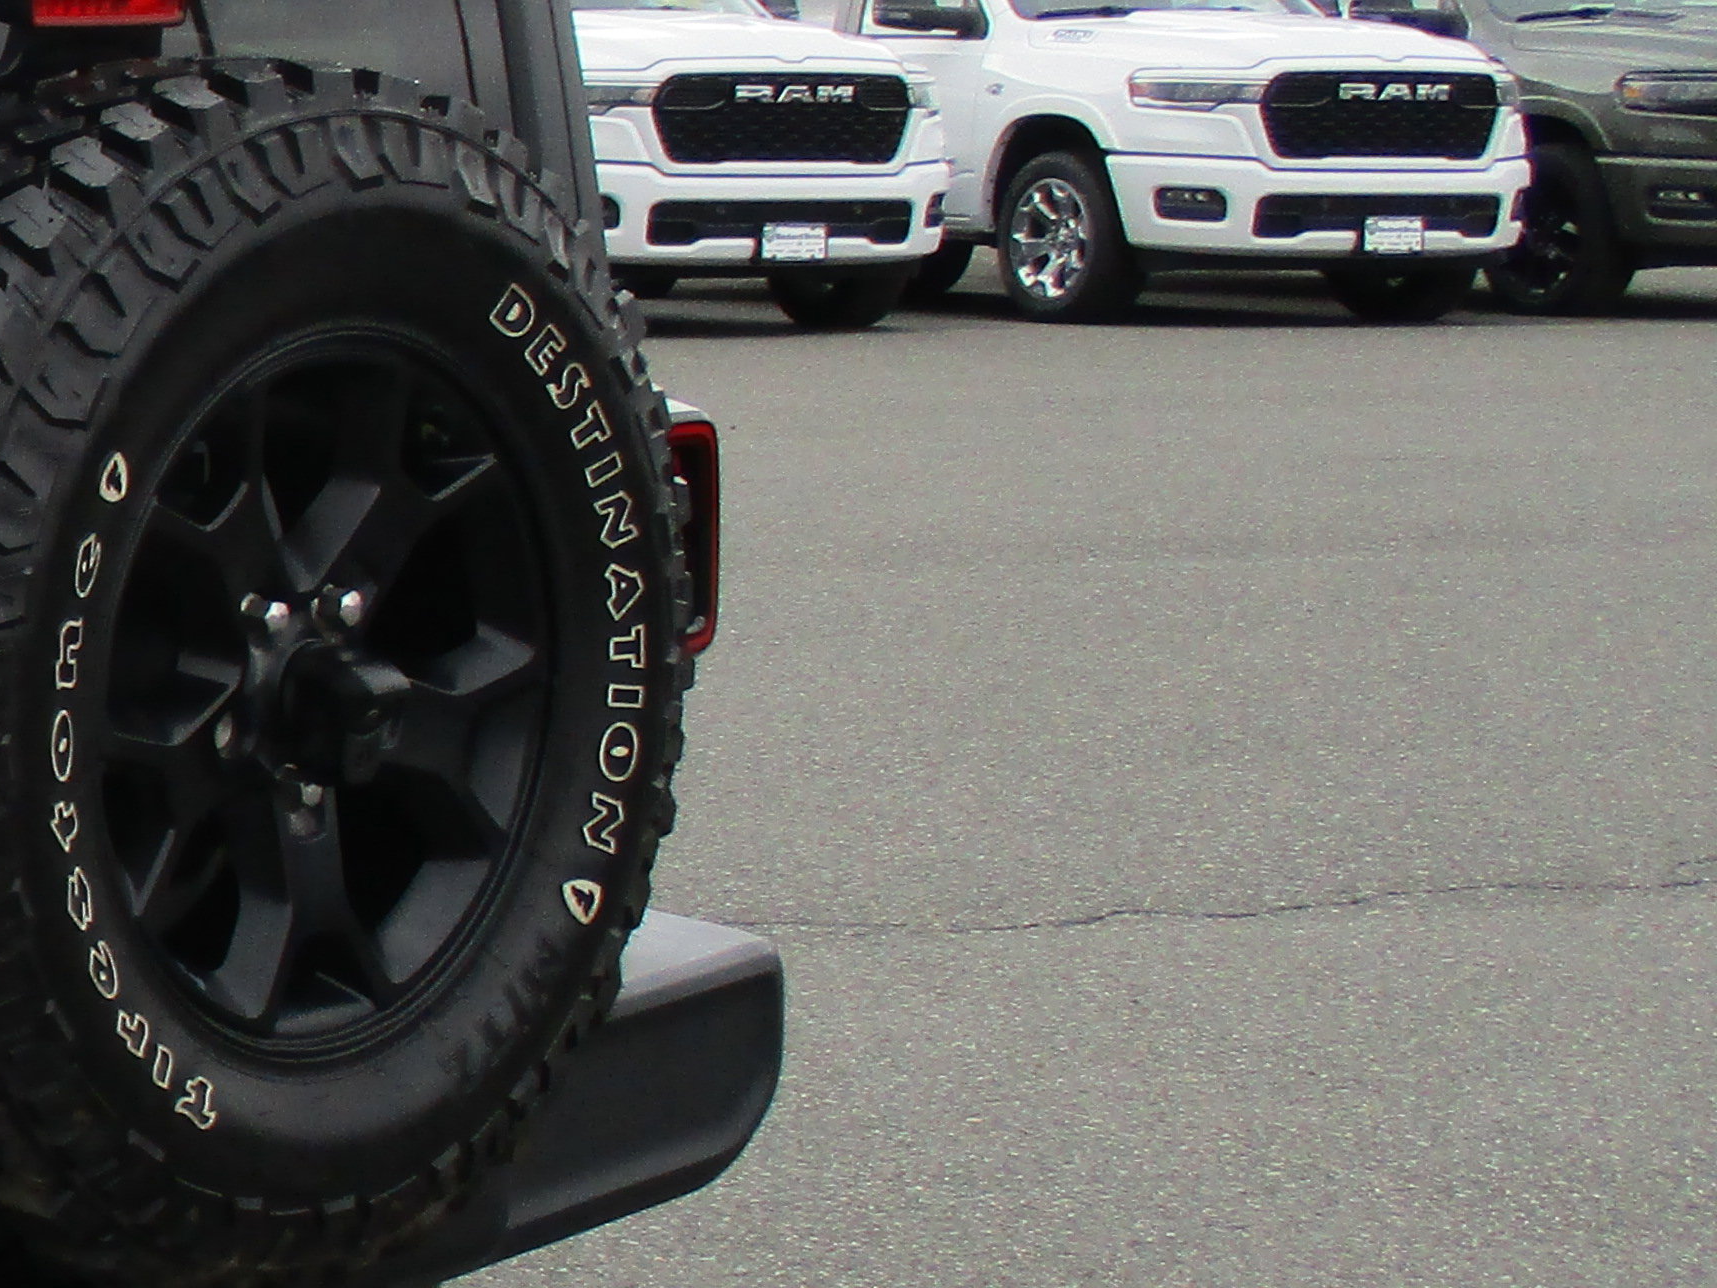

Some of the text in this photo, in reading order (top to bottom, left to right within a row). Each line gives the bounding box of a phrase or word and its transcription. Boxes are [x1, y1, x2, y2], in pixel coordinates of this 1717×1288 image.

[735, 85, 854, 103] RAM
[1339, 83, 1451, 101] RAM
[488, 283, 648, 854] DESTINATION
